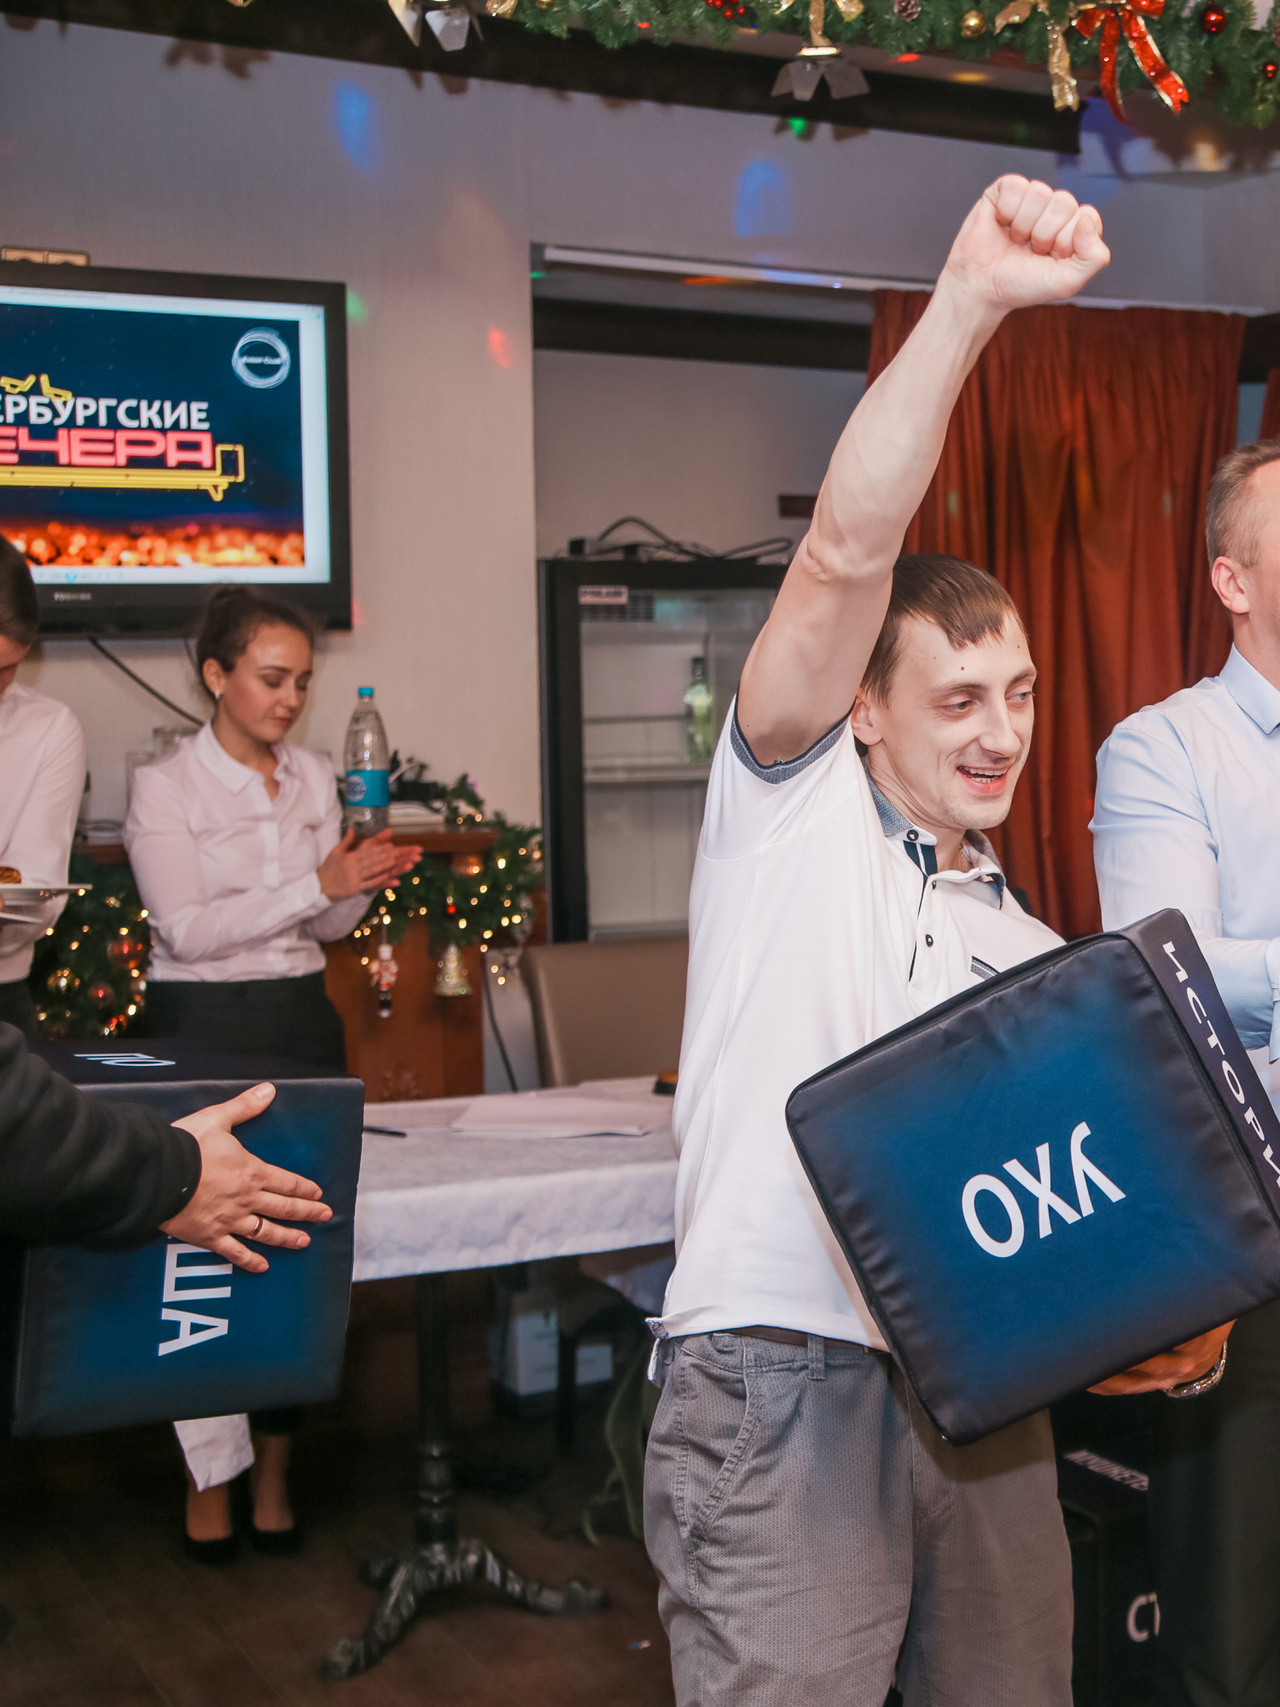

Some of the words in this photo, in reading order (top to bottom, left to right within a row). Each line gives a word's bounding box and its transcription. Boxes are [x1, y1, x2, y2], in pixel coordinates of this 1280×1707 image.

[0, 394, 211, 430] РБУРГСКИЕ
[961, 1120, 1127, 1258] УХО
[158, 1242, 233, 1357] ША
